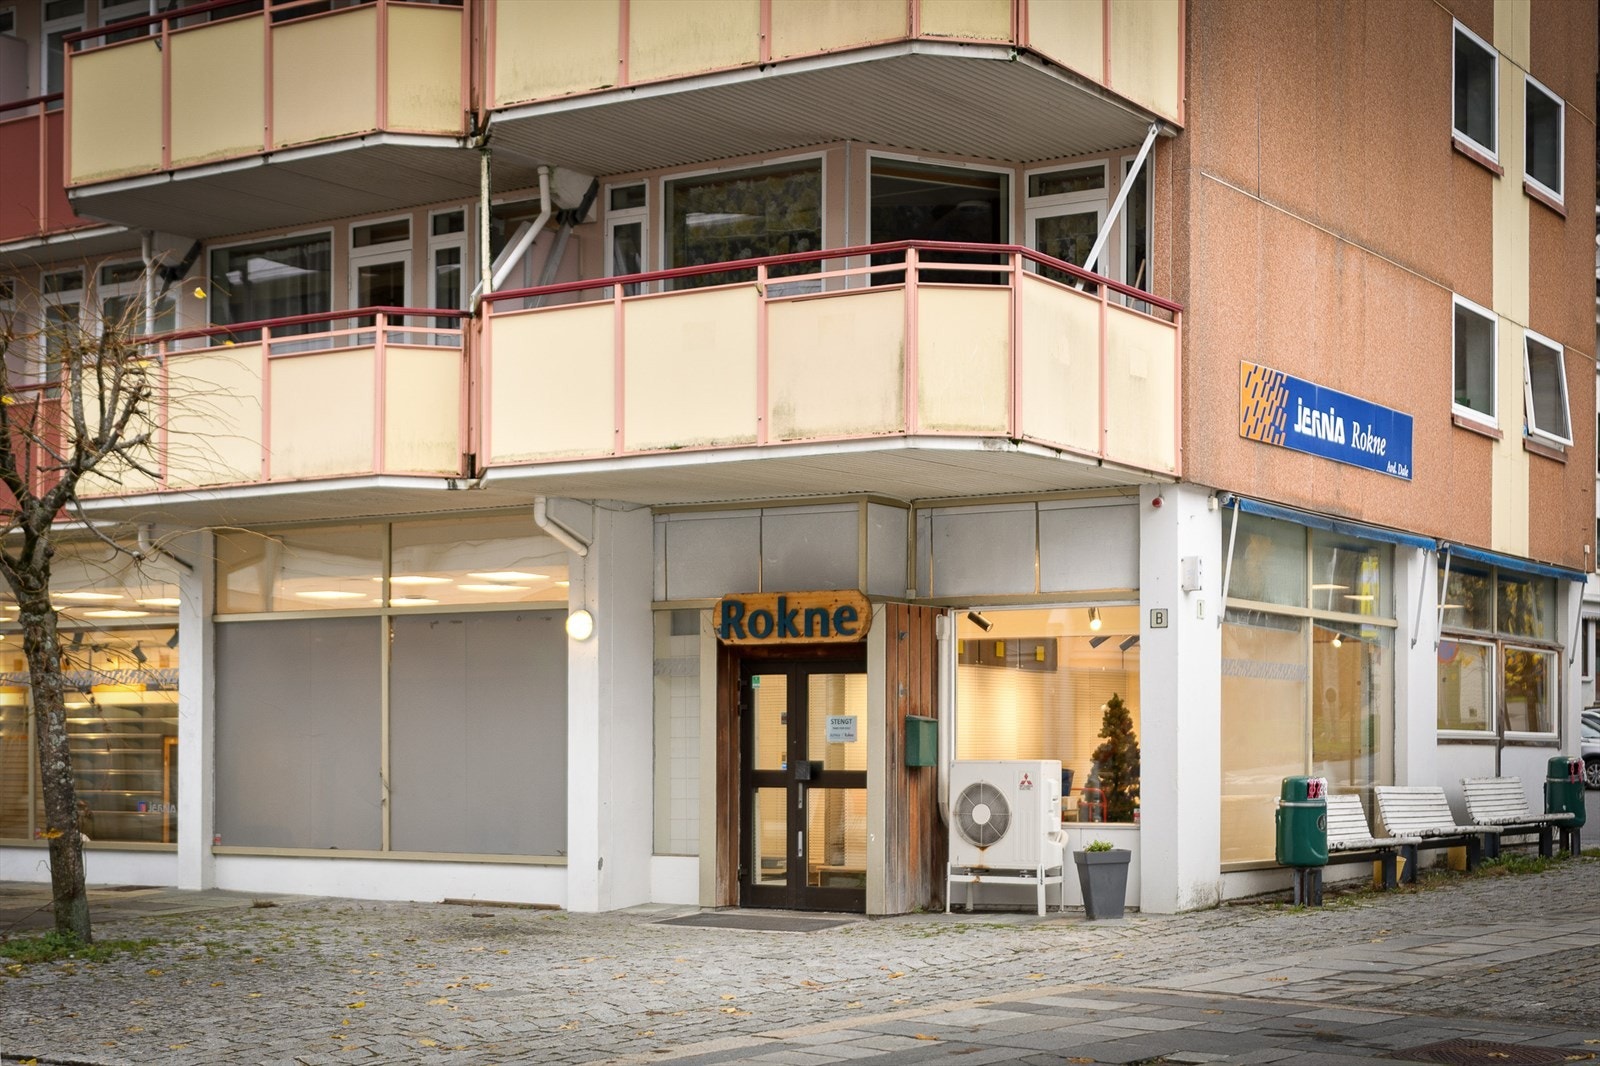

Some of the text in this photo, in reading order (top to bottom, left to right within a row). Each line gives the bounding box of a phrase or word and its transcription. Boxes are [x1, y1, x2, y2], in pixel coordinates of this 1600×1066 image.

[1351, 421, 1387, 456] Rokne
[721, 596, 858, 640] Rokne
[1156, 612, 1163, 624] B
